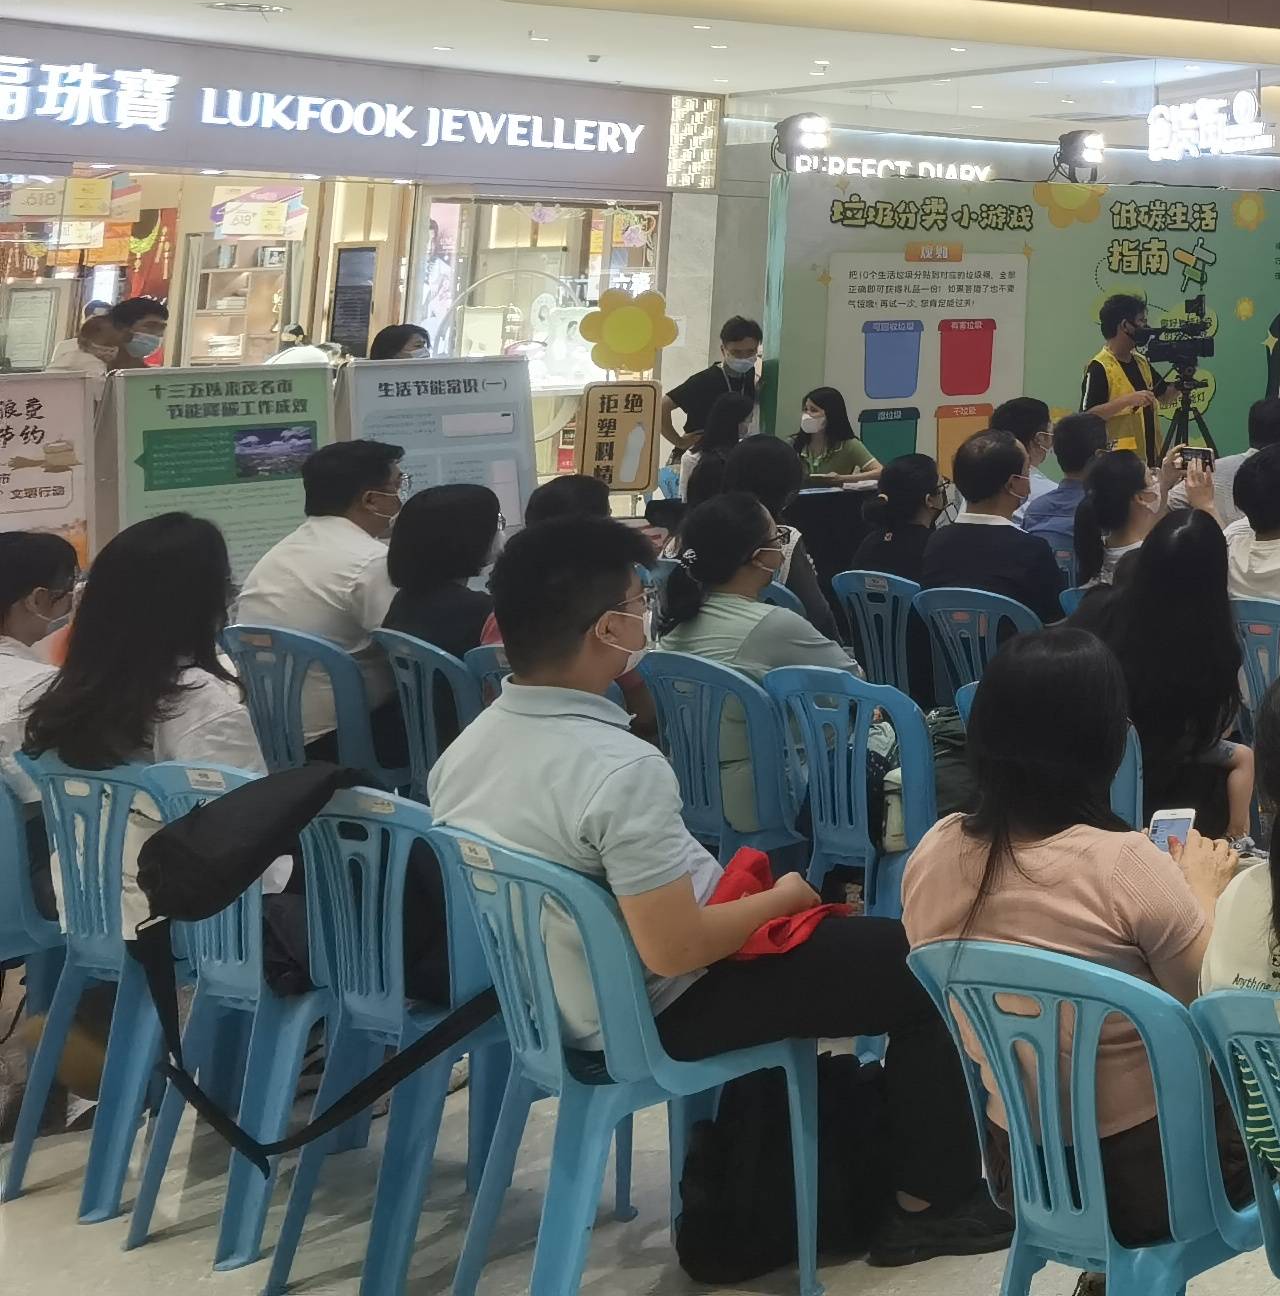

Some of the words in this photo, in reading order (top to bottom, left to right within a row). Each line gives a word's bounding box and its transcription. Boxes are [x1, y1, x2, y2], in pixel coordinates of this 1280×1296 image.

[201, 87, 417, 139] LUKFOOK
[422, 106, 646, 154] JEWELLERY
[829, 194, 948, 231] 垃圾分类
[951, 203, 1034, 232] 小游戏
[1110, 199, 1218, 233] 低碳生活
[1107, 237, 1169, 275] 指南
[598, 393, 644, 414] 拒绝
